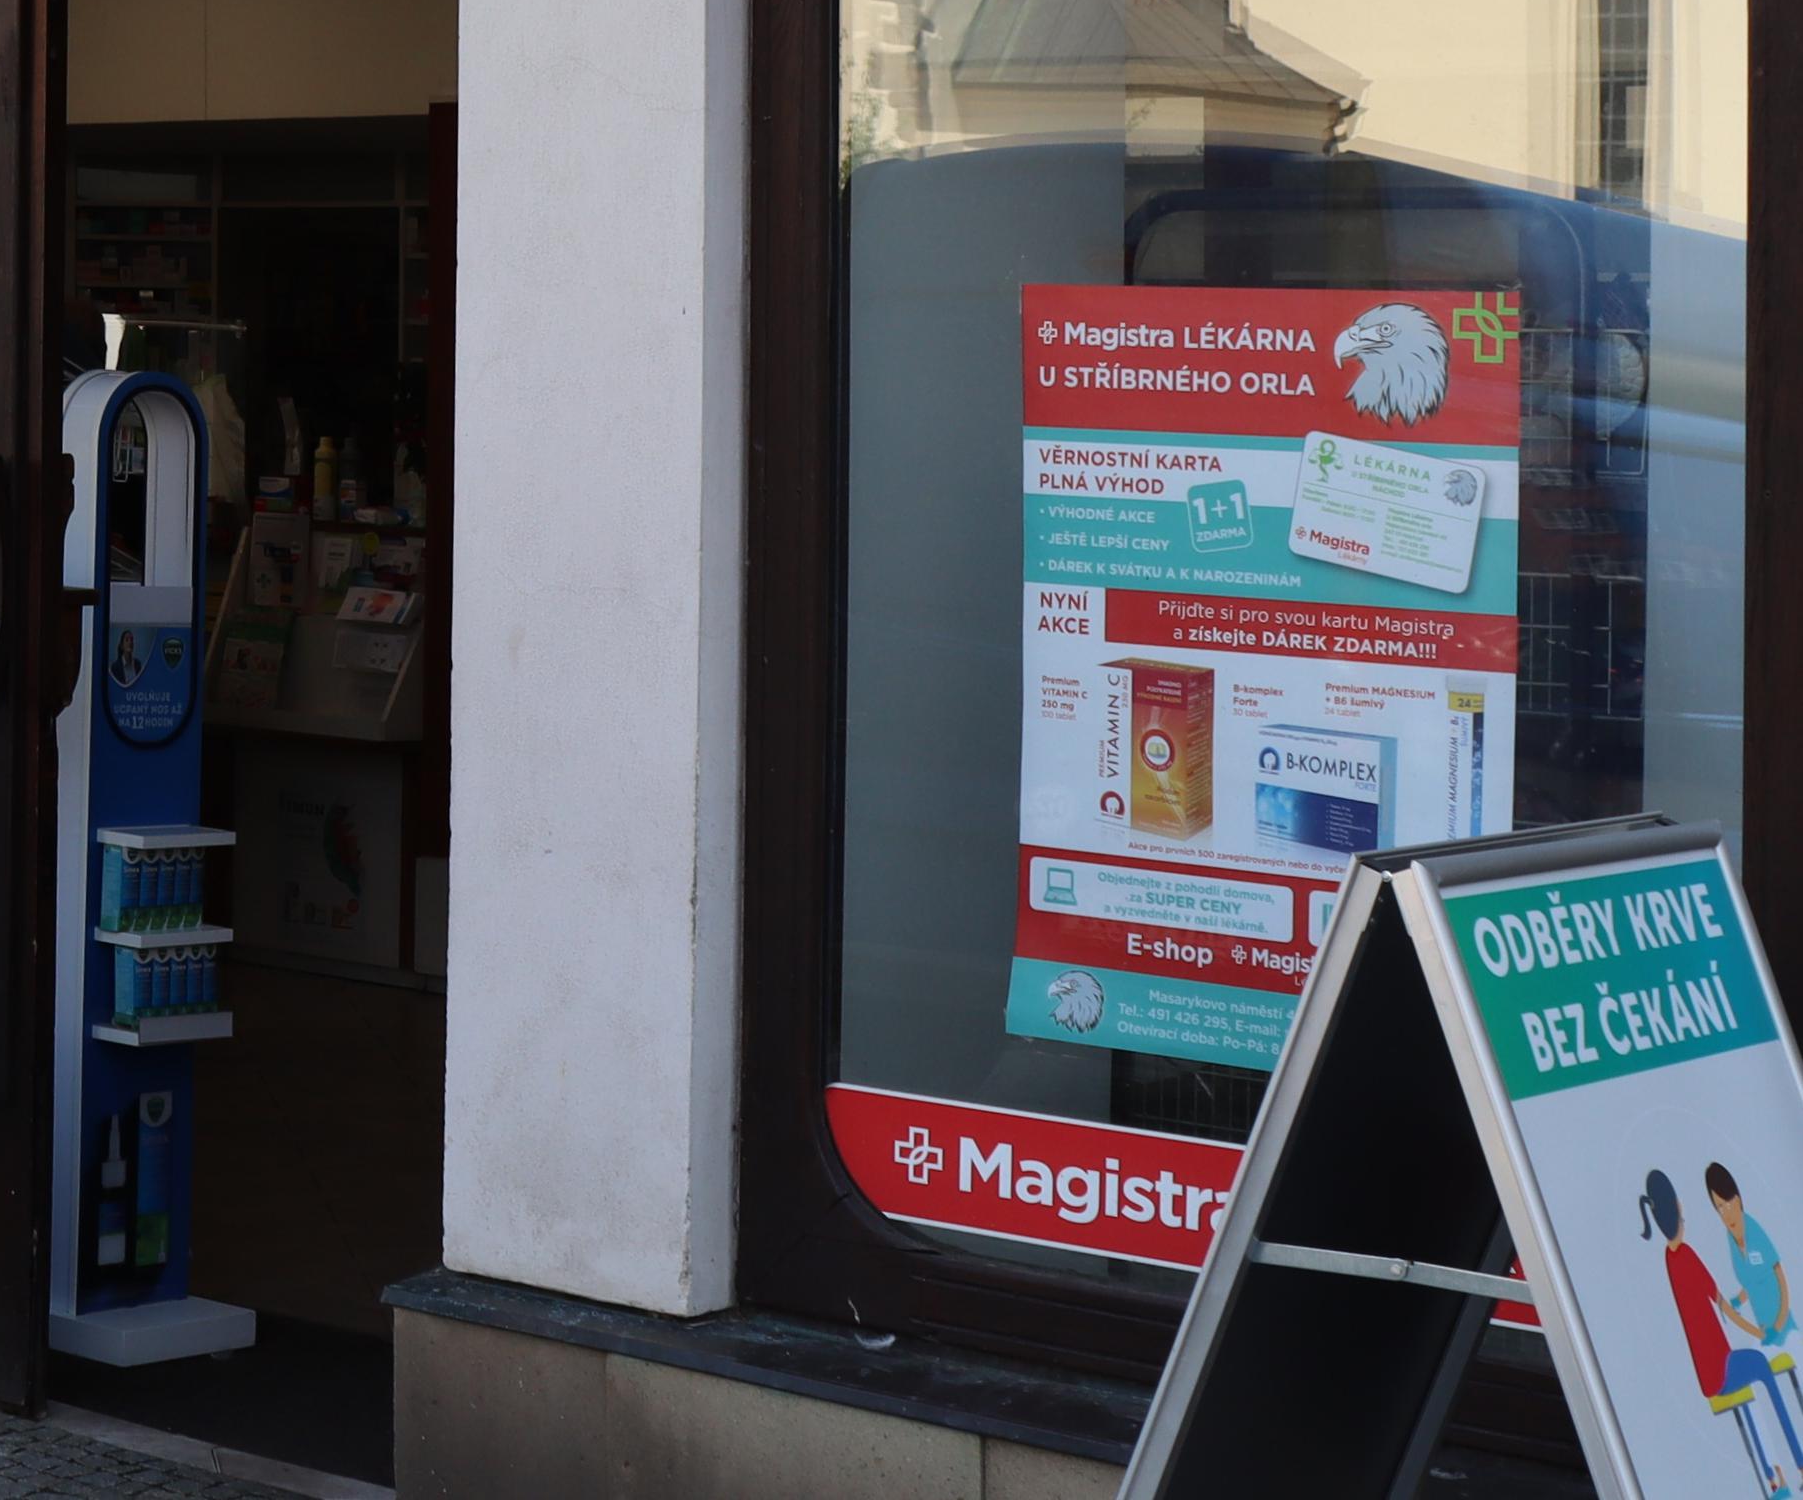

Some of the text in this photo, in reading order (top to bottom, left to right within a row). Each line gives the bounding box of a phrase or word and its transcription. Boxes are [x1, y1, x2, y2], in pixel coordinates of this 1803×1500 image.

[1064, 321, 1317, 353] Magistra LÉKÁRNA
[1038, 361, 1316, 396] U STŘÍBRNÉHO ORLA
[1038, 444, 1223, 473] VĚRNOSTNÍ KARTA
[1353, 454, 1431, 482] LÉKÁRNA
[1039, 470, 1165, 495] PLNÁ VÝHOD
[1048, 505, 1156, 524] VÝHODNÉ AKCE
[1192, 492, 1246, 526] 1+1
[1047, 531, 1170, 552] JEŠTĚ LEPŠÍ CENY
[1195, 526, 1247, 543] ZDARMA
[1308, 528, 1371, 556] Magistra
[1048, 559, 1302, 588] DÁREK K SVÁTKU A K NAROZENINÁM
[1040, 590, 1090, 612] NYNÍ
[1037, 616, 1090, 635] AKCE
[1158, 599, 1455, 640] Přijďte si pro svou kartu Magistra
[1172, 625, 1438, 661] a získejte DÁREK ZDARMA!!!
[1041, 675, 1081, 687] Premium
[1041, 687, 1088, 700] VITAMIN C
[1232, 683, 1285, 698] B-komplex
[1324, 682, 1436, 701] Premium MAGNESIUM
[1232, 696, 1259, 708] Forte
[1106, 673, 1121, 779] VITAMIN C
[1285, 751, 1378, 784] B-KOMPLEX
[1097, 871, 1161, 890] Objednejte
[1174, 881, 1221, 899] pohodlí
[1145, 891, 1196, 911] SUPER
[1200, 898, 1242, 916] CENY
[1472, 882, 1725, 978] ODBĚRY KRVE
[1126, 932, 1314, 976] E-shop Magis
[1148, 988, 1284, 1020] Masarykovo náměstí
[1520, 959, 1739, 1073] BEZ ČEKÁNÍ
[1117, 1002, 1145, 1018] Tel.:
[1147, 1007, 1171, 1022] 491
[1173, 1011, 1200, 1026] 426
[1234, 1019, 1282, 1038] E-mail:
[1117, 1020, 1179, 1041] Otevírací
[1180, 1029, 1219, 1047] doba:
